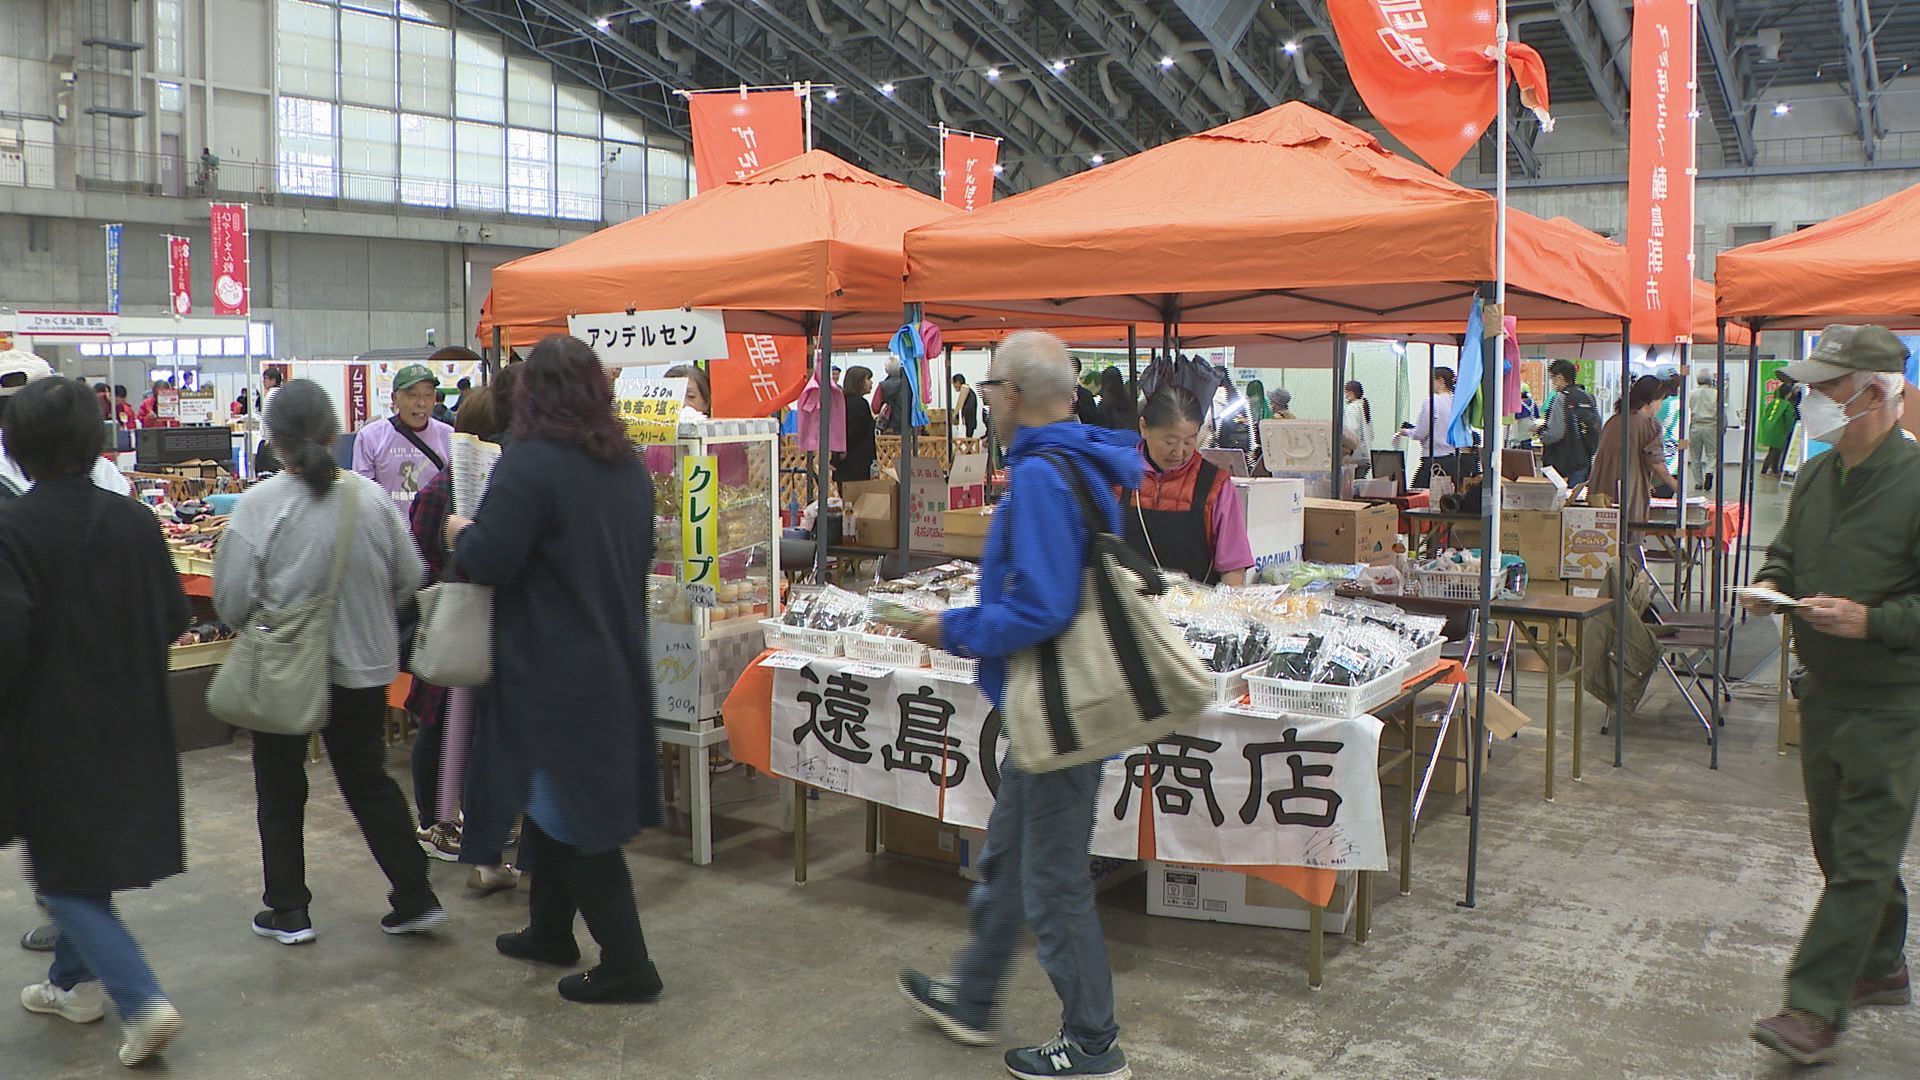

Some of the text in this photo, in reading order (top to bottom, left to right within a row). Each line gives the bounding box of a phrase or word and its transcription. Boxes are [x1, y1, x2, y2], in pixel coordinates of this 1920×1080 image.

[587, 324, 697, 348] アンデルセン
[616, 400, 679, 416] 島産の塩が
[687, 465, 714, 583] クレープ
[1255, 551, 1291, 573] SAGAWA
